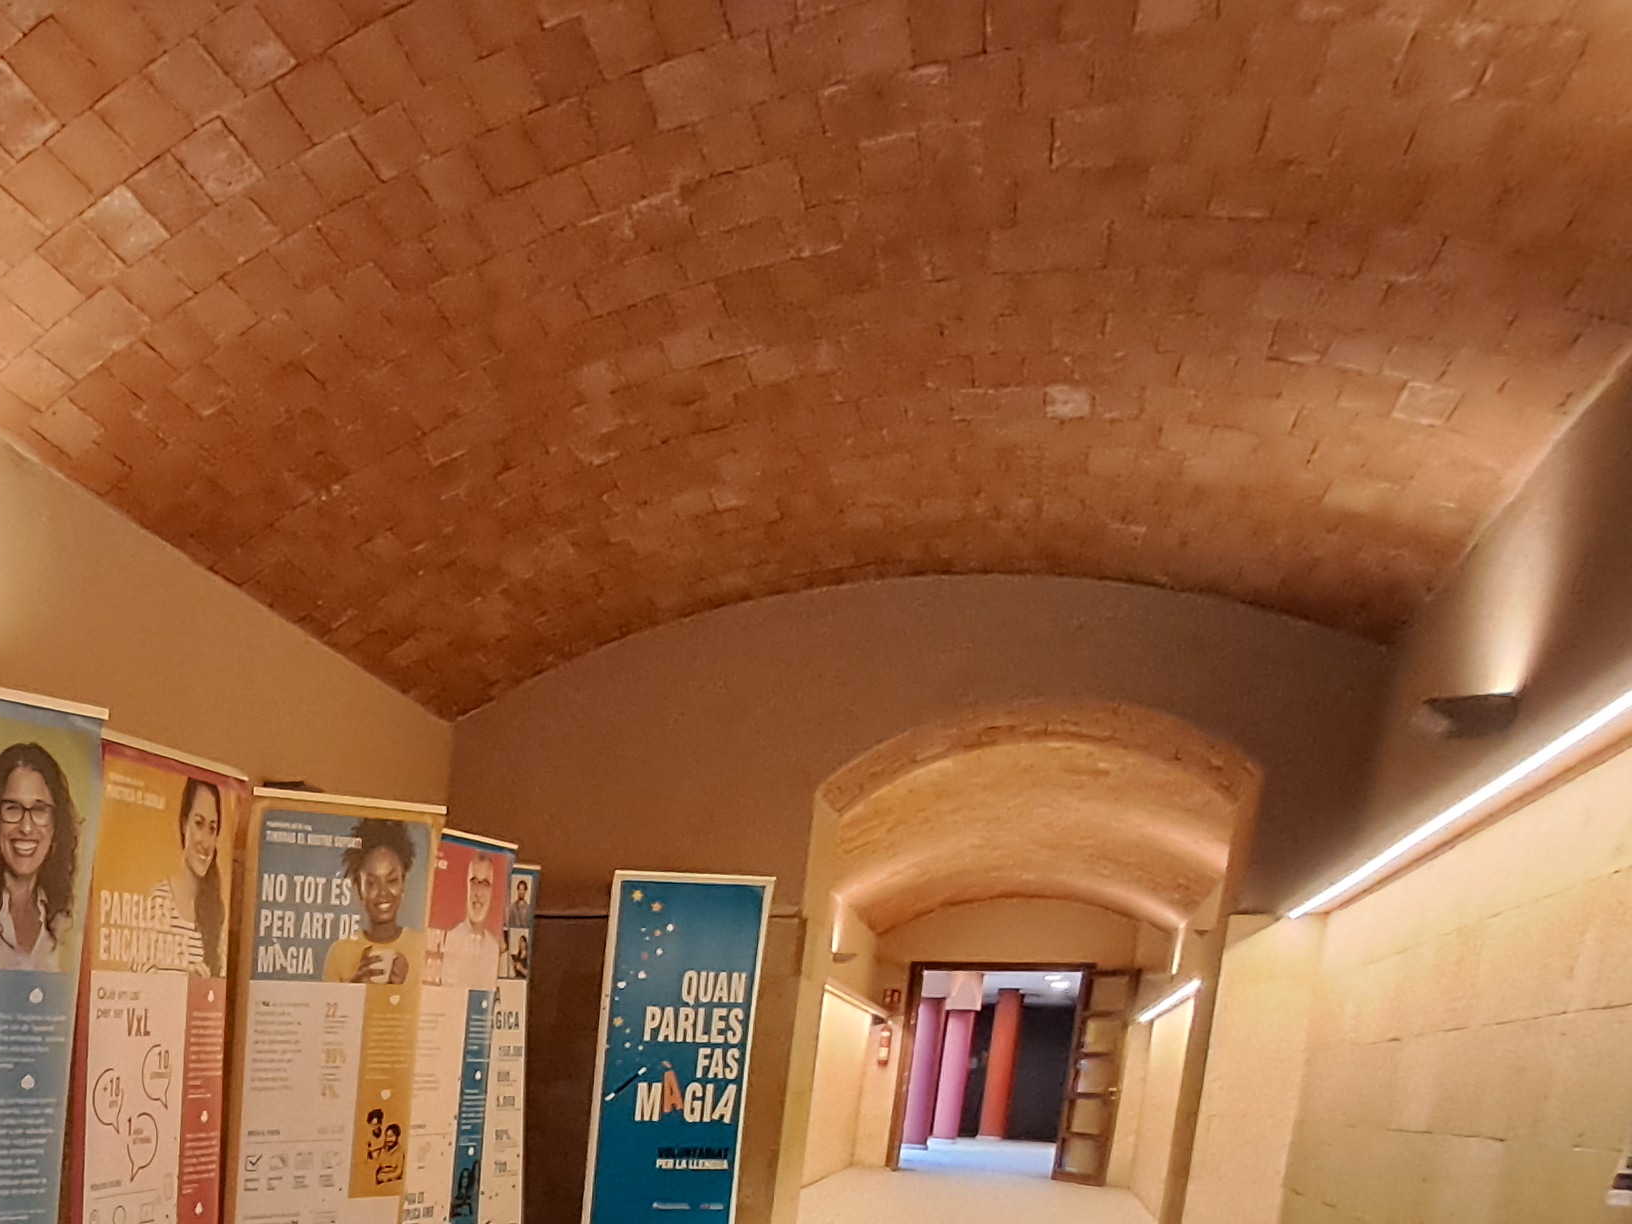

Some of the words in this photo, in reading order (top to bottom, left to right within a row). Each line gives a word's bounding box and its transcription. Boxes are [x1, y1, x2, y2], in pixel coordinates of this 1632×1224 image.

[262, 873, 287, 903] NO
[294, 875, 326, 904] TOT
[330, 871, 352, 906] ÉS
[260, 909, 294, 939] PER
[300, 911, 334, 939] ART
[339, 914, 360, 940] DE
[258, 939, 314, 975] MÀGIA
[682, 970, 747, 1005] QUAN
[127, 1008, 150, 1036] VxL
[492, 1011, 519, 1030] GICA
[643, 1006, 744, 1043] PARLES
[696, 1047, 741, 1080] FAS
[635, 1060, 738, 1125] MÀGIA
